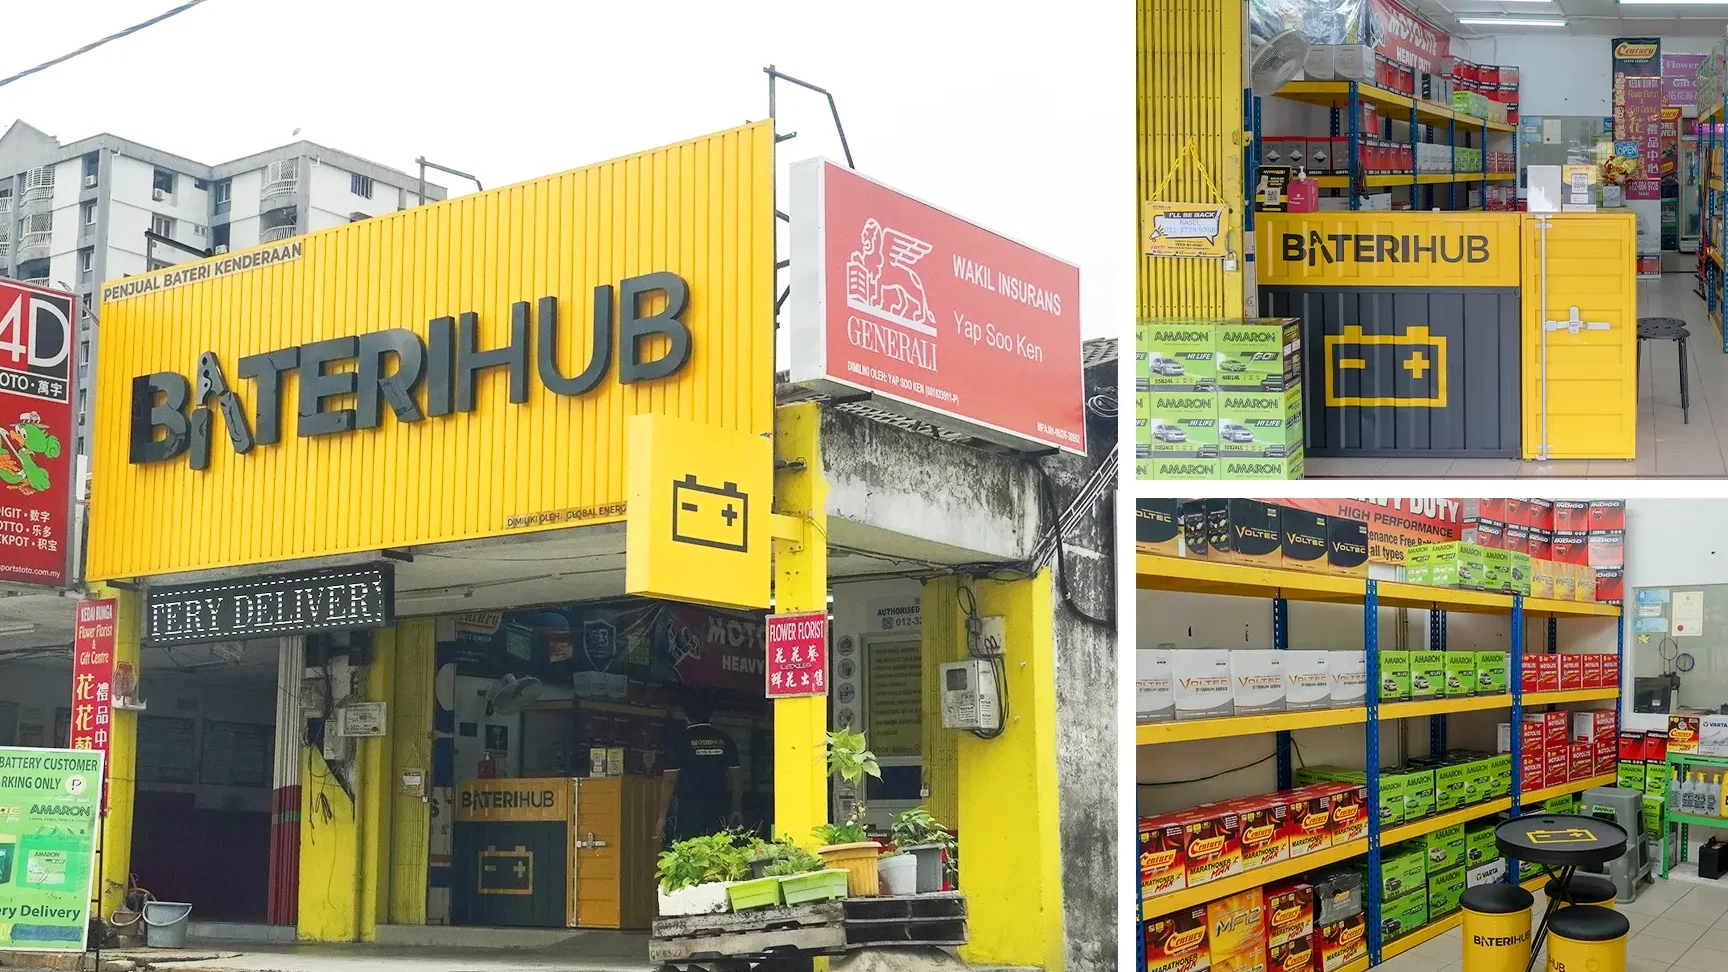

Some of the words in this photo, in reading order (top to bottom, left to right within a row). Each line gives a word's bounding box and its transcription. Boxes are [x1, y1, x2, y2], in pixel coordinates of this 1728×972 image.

[1388, 11, 1437, 57] MOTOLITE
[1396, 45, 1417, 67] HEAVY
[1616, 42, 1658, 56] Century
[1666, 61, 1699, 69] Flower
[1673, 78, 1690, 87] Gift
[1616, 144, 1638, 156] OPEN
[1282, 230, 1490, 267] BATERIHUB
[103, 277, 161, 303] PENJUAL
[164, 269, 210, 288] BATERI
[215, 243, 301, 275] KENDERAAN
[952, 253, 996, 292] WAKIL
[998, 270, 1062, 317] INSURANS
[953, 310, 982, 345] Yap
[986, 323, 1012, 351] Soo
[1016, 340, 1043, 363] Ken
[1154, 331, 1209, 342] AMARON
[1223, 331, 1276, 342] AMARON
[847, 315, 938, 373] GENERALI
[129, 270, 692, 471] BATERIHUB
[888, 374, 900, 386] YAP
[900, 378, 913, 390] SOO
[913, 381, 925, 394] KEN
[1156, 397, 1212, 409] AMARON
[1224, 397, 1279, 409] AMARON
[1199, 419, 1215, 427] LIFE
[1267, 419, 1281, 427] LIFE
[1160, 464, 1214, 475] AMARON
[1227, 463, 1282, 474] AMARON
[29, 509, 50, 523] 数字
[566, 508, 598, 519] GLOBAL
[1338, 505, 1371, 521] HIGH
[1373, 512, 1453, 538] PERFORMANCE
[32, 524, 52, 537] 乐多
[1235, 525, 1278, 540] VOLTEC
[1287, 532, 1325, 547] VOLTEC
[1400, 534, 1417, 546] Free
[1332, 541, 1366, 554] VOLTEC
[1370, 545, 1380, 557] all
[1383, 547, 1404, 561] types
[81, 606, 95, 622] KEDAI
[95, 604, 113, 621] BUNGA
[877, 605, 920, 617] AUTHORISED
[79, 626, 96, 639] Flower
[96, 624, 113, 638] Florist
[770, 624, 796, 642] FLOWER
[798, 620, 824, 639] FLORIST
[80, 652, 91, 665] Gift
[91, 651, 109, 664] Centre
[722, 654, 764, 675] HEAVY
[1179, 677, 1228, 690] VOLTEC
[1238, 676, 1280, 687] VOLTEC
[1288, 674, 1327, 685] VOLTEC
[43, 757, 98, 772] CUSTOMER
[1466, 765, 1488, 775] AMARON
[1406, 775, 1432, 787] AMARON
[1439, 769, 1463, 780] AMARON
[35, 777, 62, 790] ONLY
[461, 790, 555, 811] BATERIHUB
[30, 803, 91, 817] AMARON
[1334, 807, 1357, 821] Century
[1303, 815, 1328, 829] Century
[1243, 827, 1273, 843] Century
[1434, 826, 1460, 840] AMARON
[1190, 840, 1223, 856] Century
[1243, 845, 1280, 861] MARATHONER
[1190, 858, 1231, 875] MARATHONER
[1482, 867, 1498, 878] VARTA
[1435, 870, 1460, 887] AMARON
[20, 905, 81, 921] Delivery
[1166, 930, 1204, 951] Century
[1474, 930, 1531, 947] BATERIHUB
